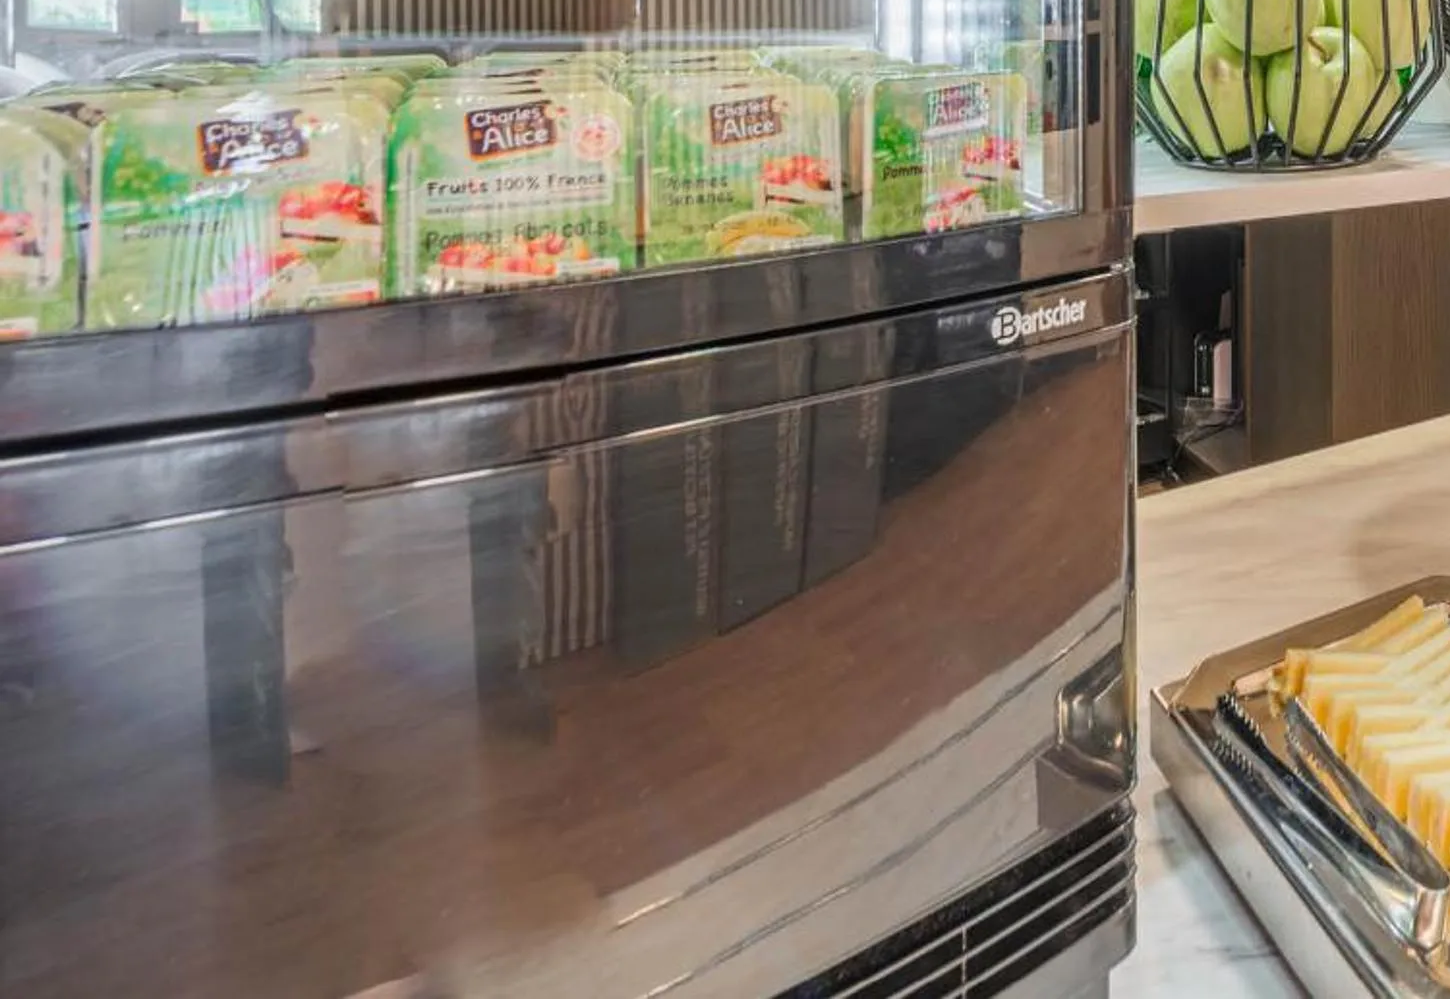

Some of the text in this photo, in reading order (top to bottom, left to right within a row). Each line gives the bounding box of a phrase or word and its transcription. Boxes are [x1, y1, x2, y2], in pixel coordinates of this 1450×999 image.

[471, 105, 542, 128] Charles
[722, 118, 776, 142] Alice
[482, 125, 550, 153] Alice
[219, 139, 300, 168] Ace
[426, 171, 606, 198] Fruits 100% France
[883, 165, 925, 182] Pomm
[990, 297, 1088, 346] Bartscher
